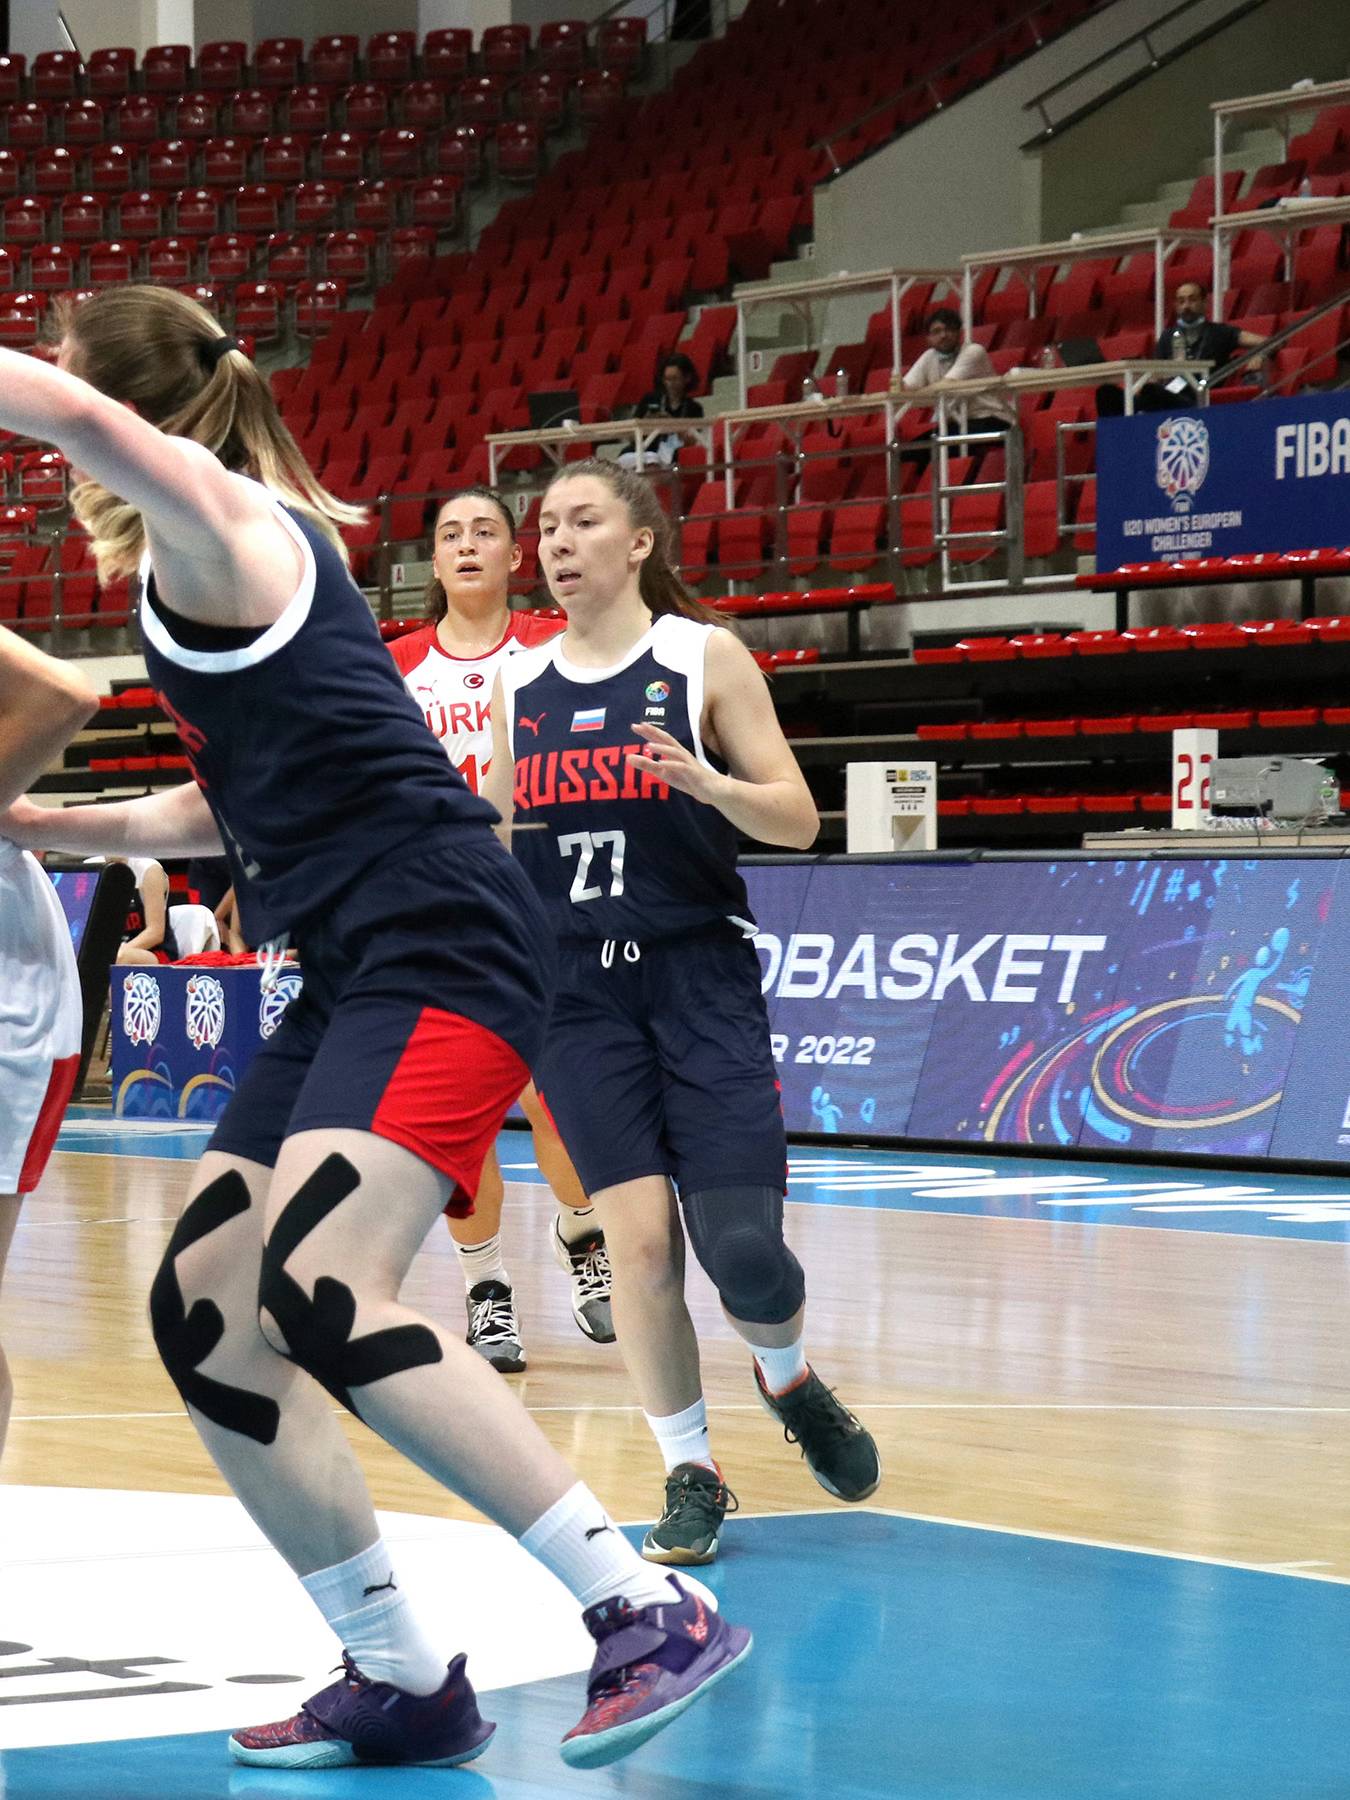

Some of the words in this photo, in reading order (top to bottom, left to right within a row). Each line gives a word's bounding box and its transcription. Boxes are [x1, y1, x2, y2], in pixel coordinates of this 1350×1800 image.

[1276, 418, 1350, 480] FIBA
[1123, 519, 1144, 537] U20
[1144, 514, 1191, 535] WOMEN'S
[1191, 510, 1242, 531] EUROPEAN
[1151, 531, 1212, 552] CHALLENGER
[645, 706, 666, 717] FIBA
[557, 830, 626, 904] 27
[793, 1035, 876, 1065] 2022
